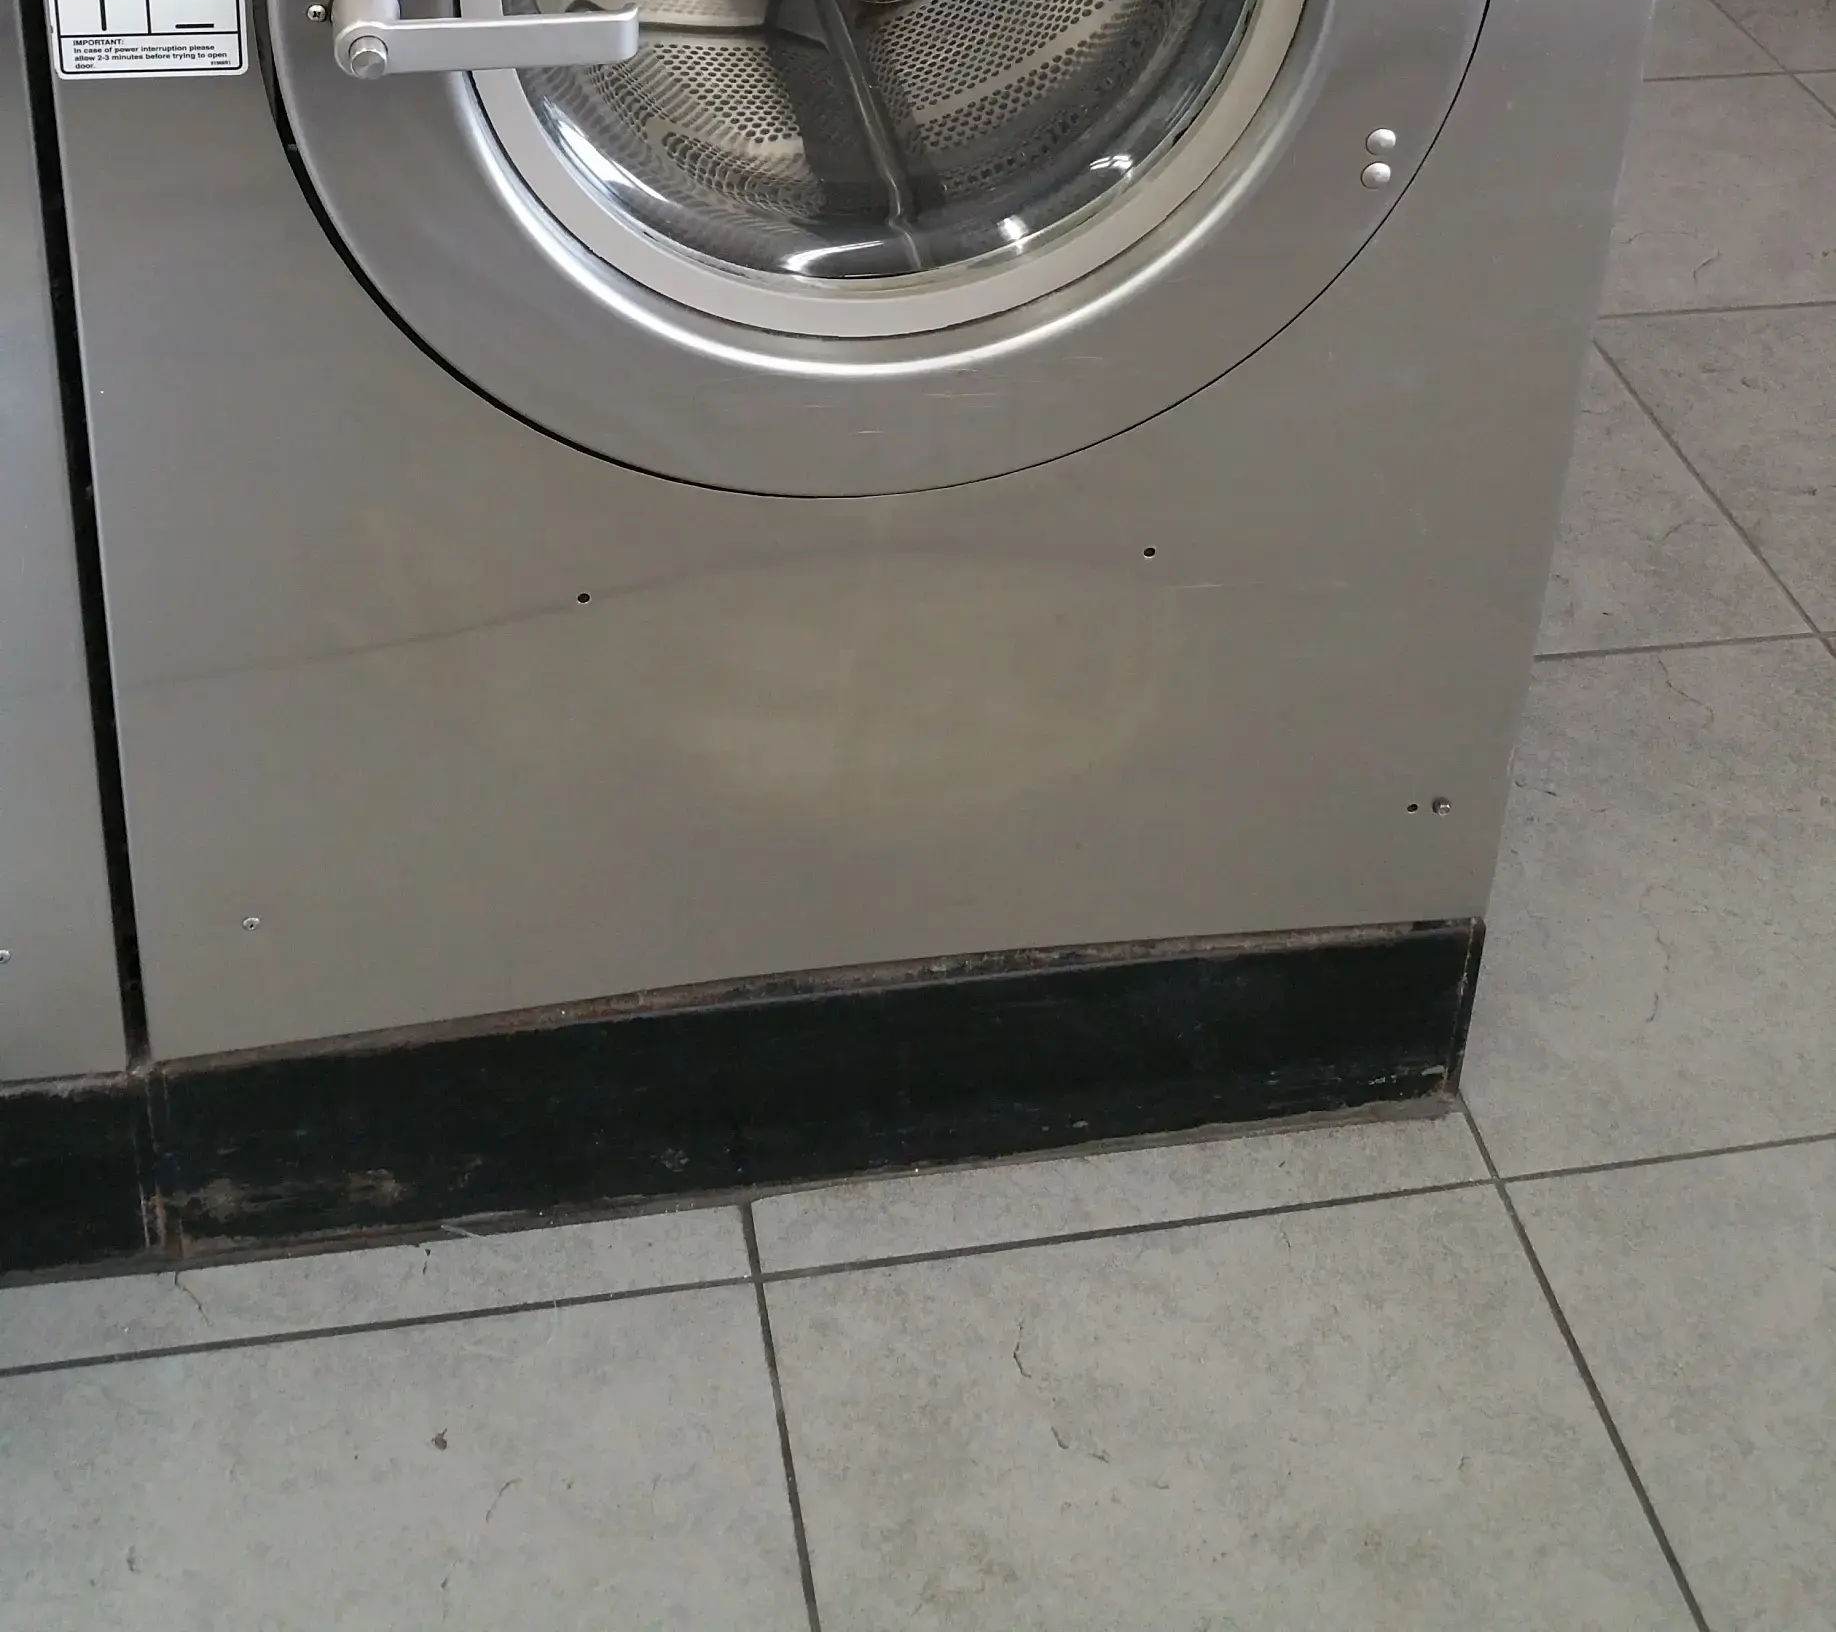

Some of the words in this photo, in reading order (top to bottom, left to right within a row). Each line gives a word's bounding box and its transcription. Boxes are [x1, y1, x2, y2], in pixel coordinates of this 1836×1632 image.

[114, 46, 138, 54] power
[141, 45, 187, 53] interruption
[173, 52, 196, 60] trying
